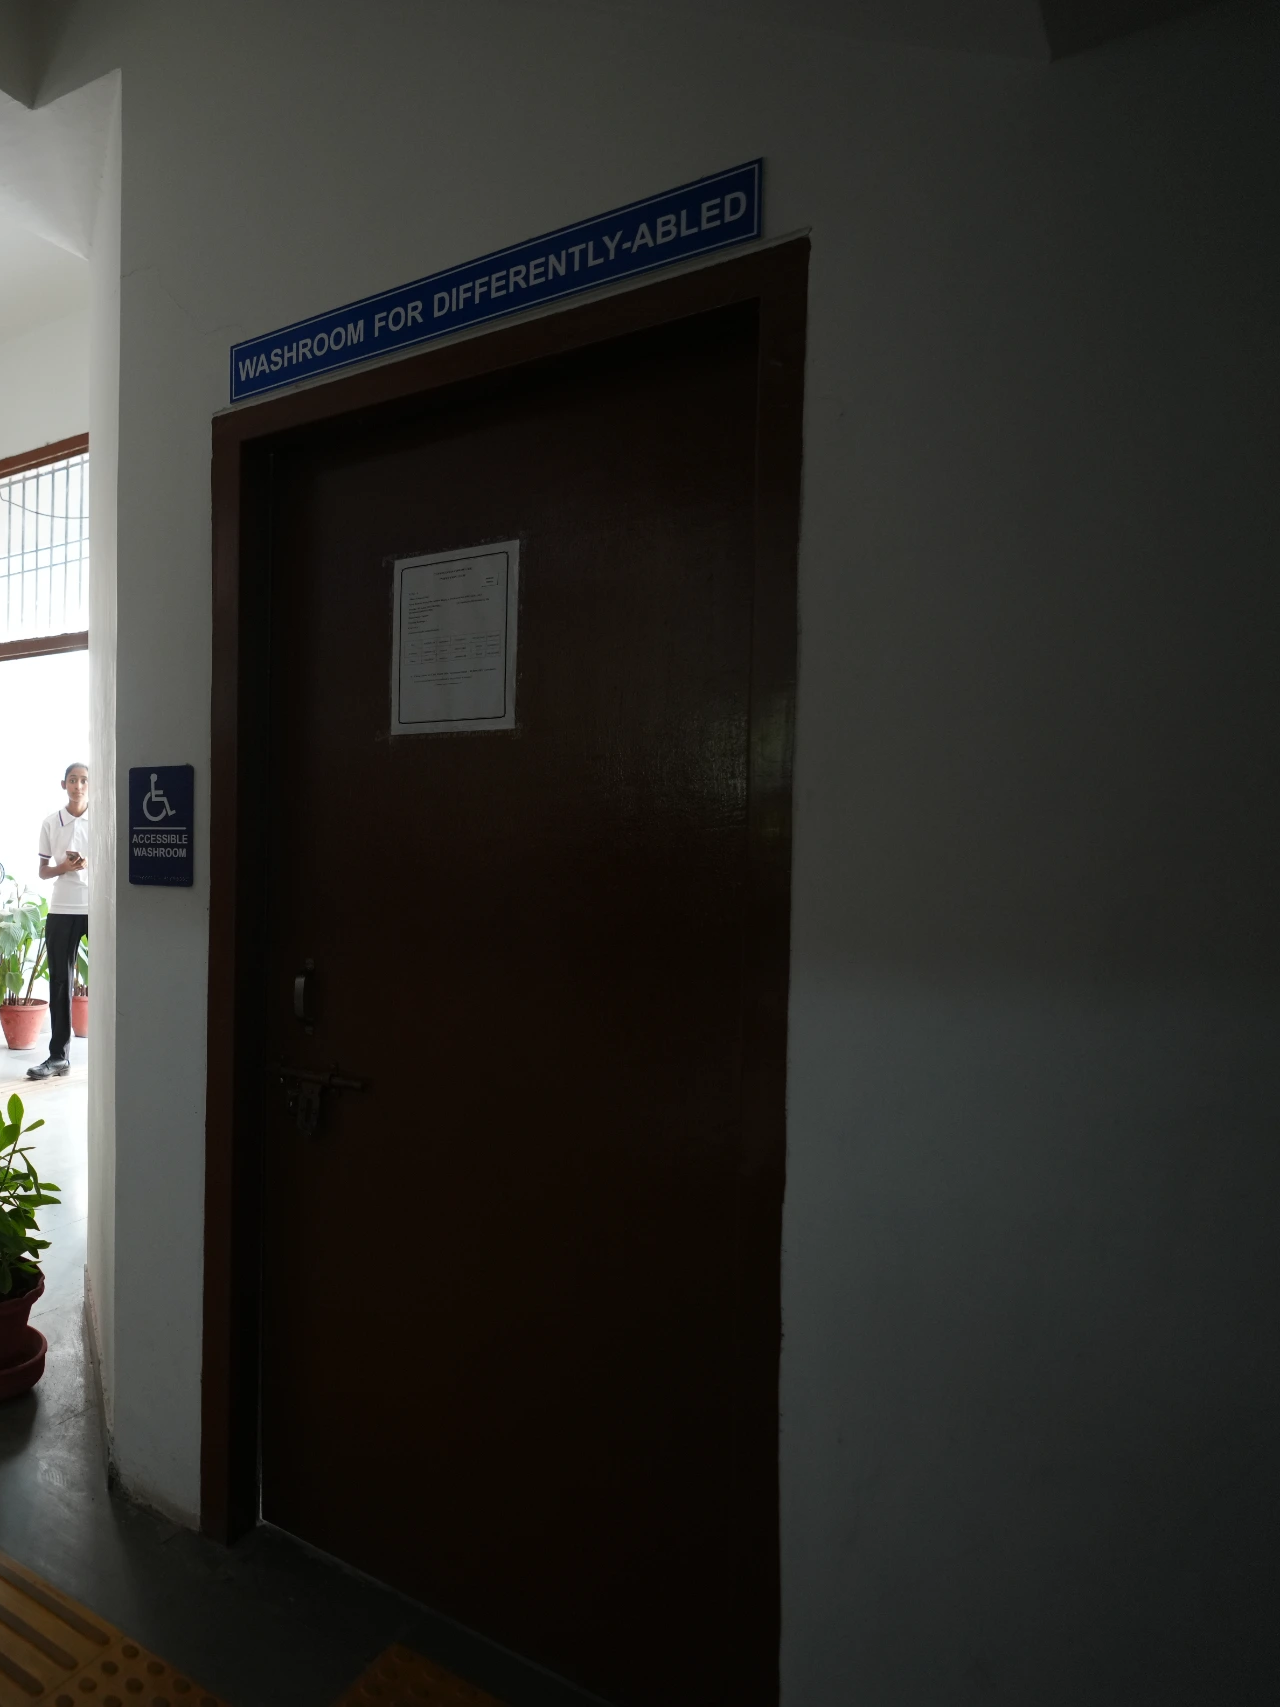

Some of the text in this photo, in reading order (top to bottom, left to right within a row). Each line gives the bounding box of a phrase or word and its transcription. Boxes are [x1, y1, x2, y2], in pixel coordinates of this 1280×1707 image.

[237, 190, 748, 382] WASHROOM FOR DIFFERENTLY-ABLED
[132, 834, 188, 844] ACCESSIBLE
[133, 847, 187, 858] WASHROOM
